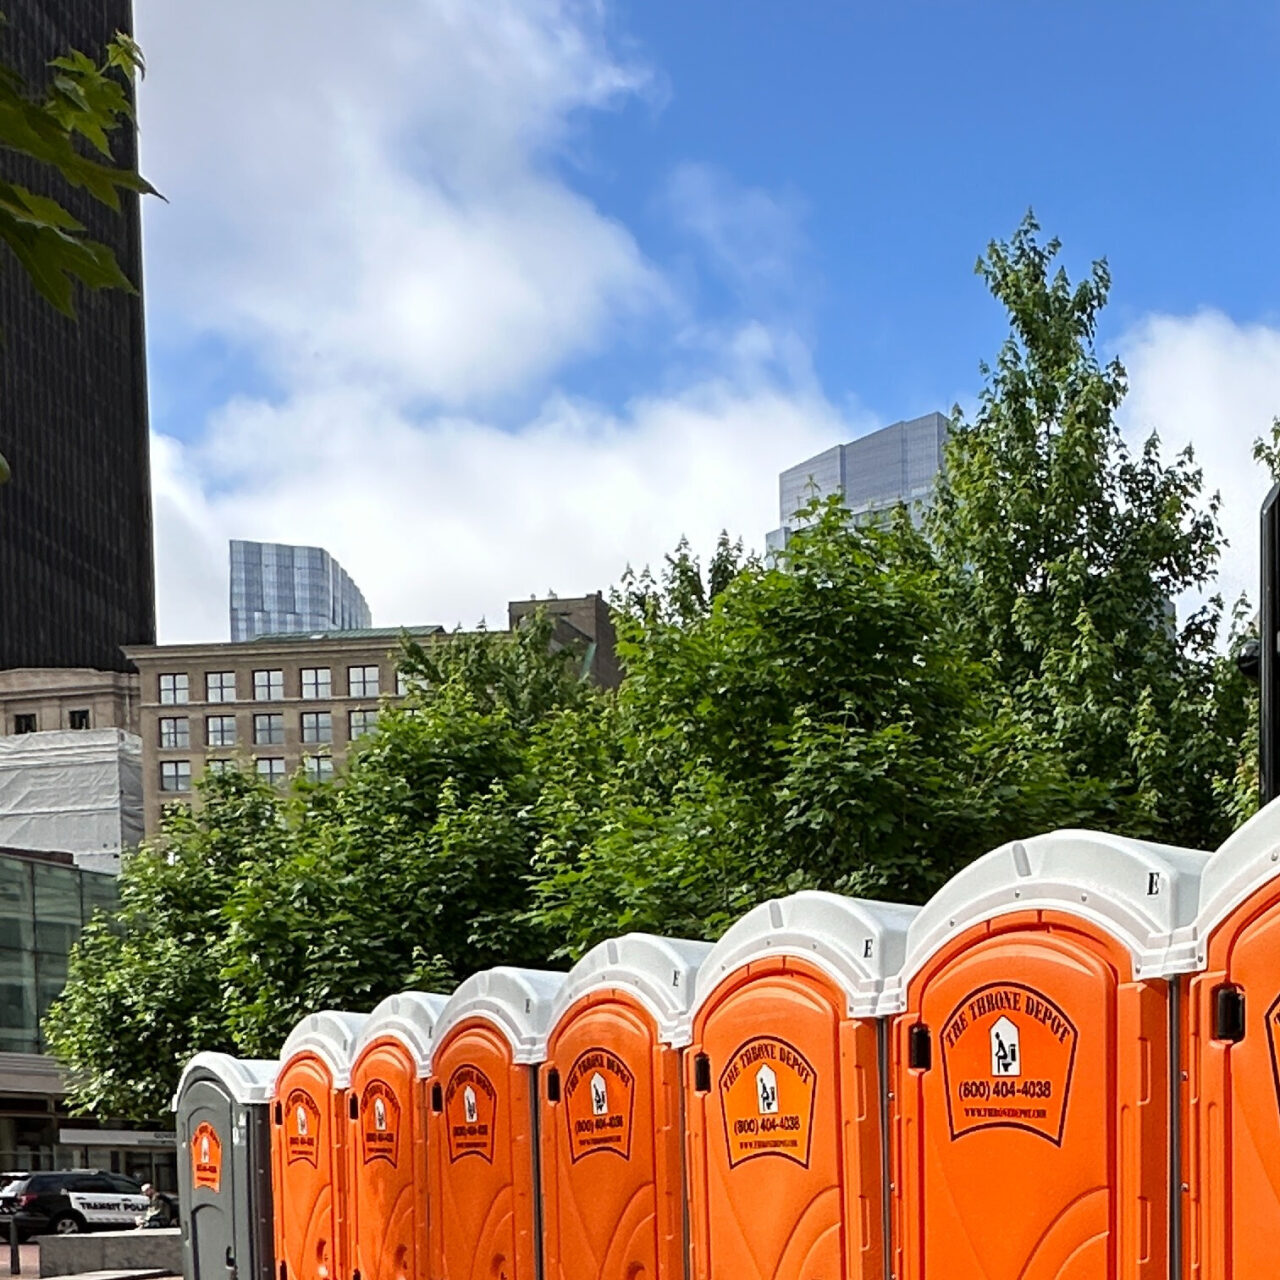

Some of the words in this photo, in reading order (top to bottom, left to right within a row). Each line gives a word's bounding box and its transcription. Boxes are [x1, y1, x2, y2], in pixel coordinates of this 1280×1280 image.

[1147, 872, 1160, 896] E
[863, 938, 873, 958] E
[945, 1011, 969, 1049] THE
[968, 990, 1022, 1023] THRONE
[1024, 995, 1071, 1045] DEPOT
[993, 1081, 1052, 1099] 404-4038
